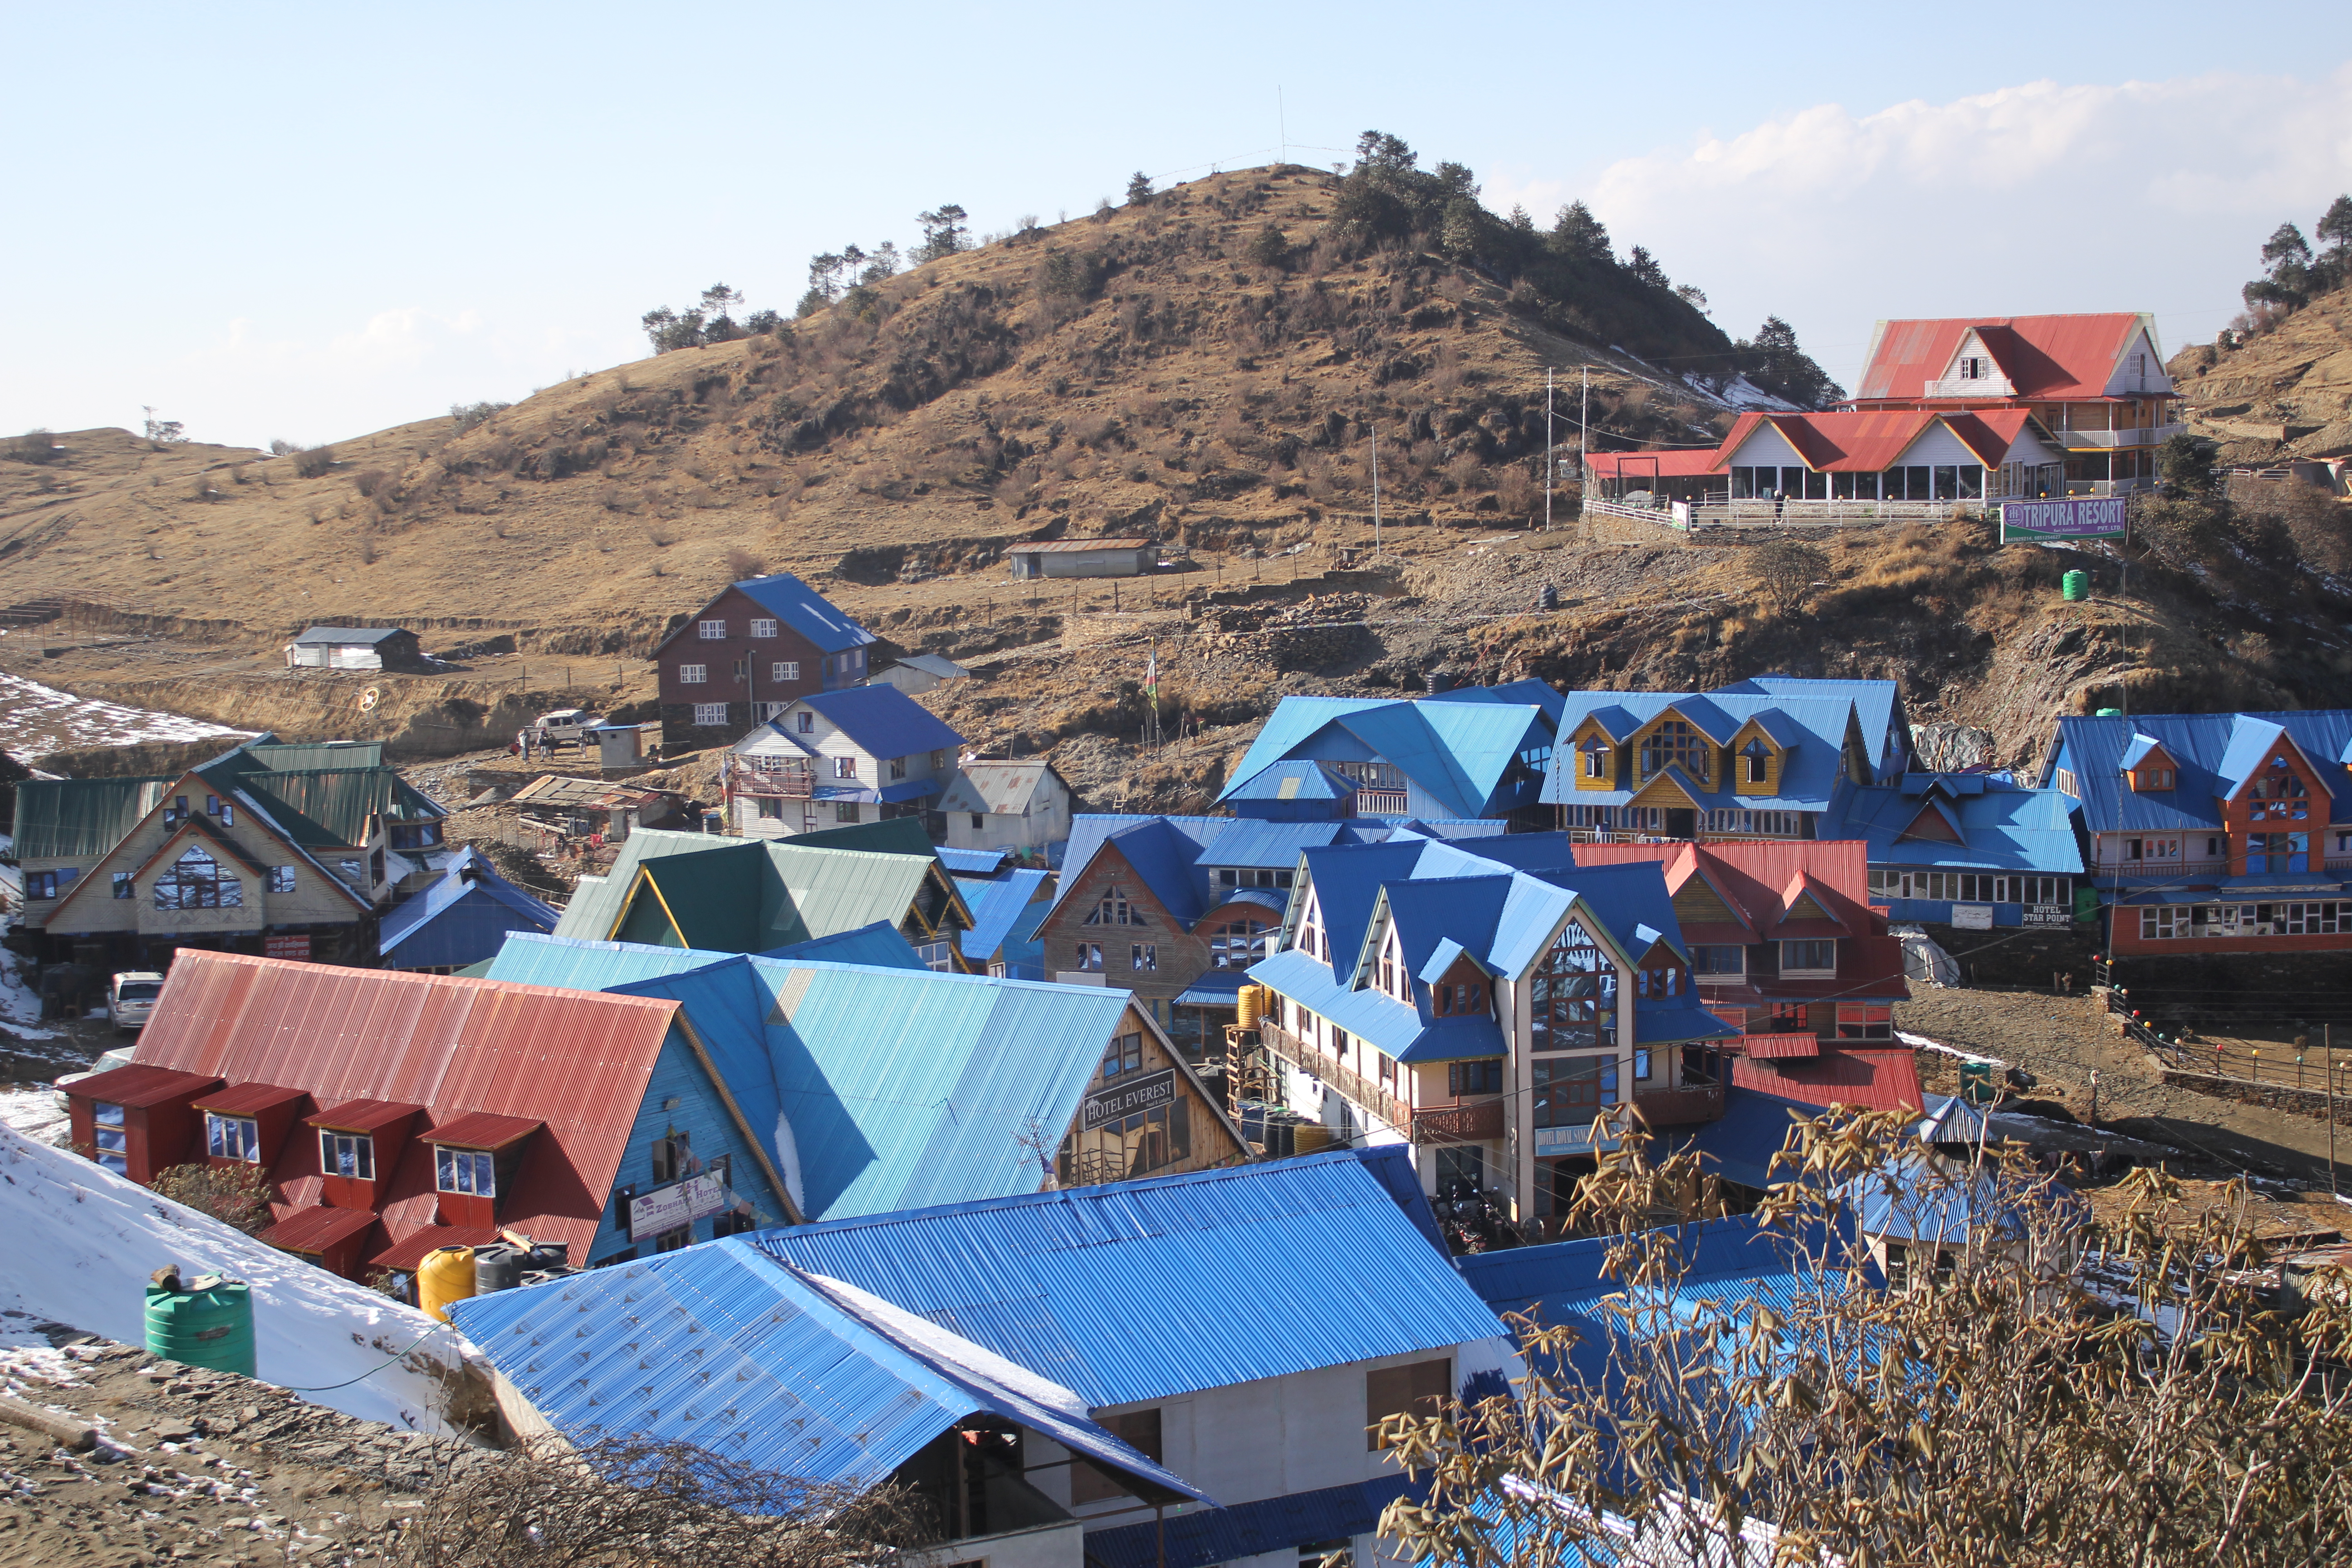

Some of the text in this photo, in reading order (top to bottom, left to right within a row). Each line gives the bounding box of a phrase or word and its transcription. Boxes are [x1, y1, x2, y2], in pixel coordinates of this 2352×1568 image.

[2024, 500, 2122, 528] TRIPURA RESORT
[2033, 906, 2061, 914] HOTEL
[1088, 1080, 1172, 1122] HOTEL EVEREST
[1539, 1131, 1555, 1146] HOTEL
[1557, 1129, 1573, 1144] ROYAL
